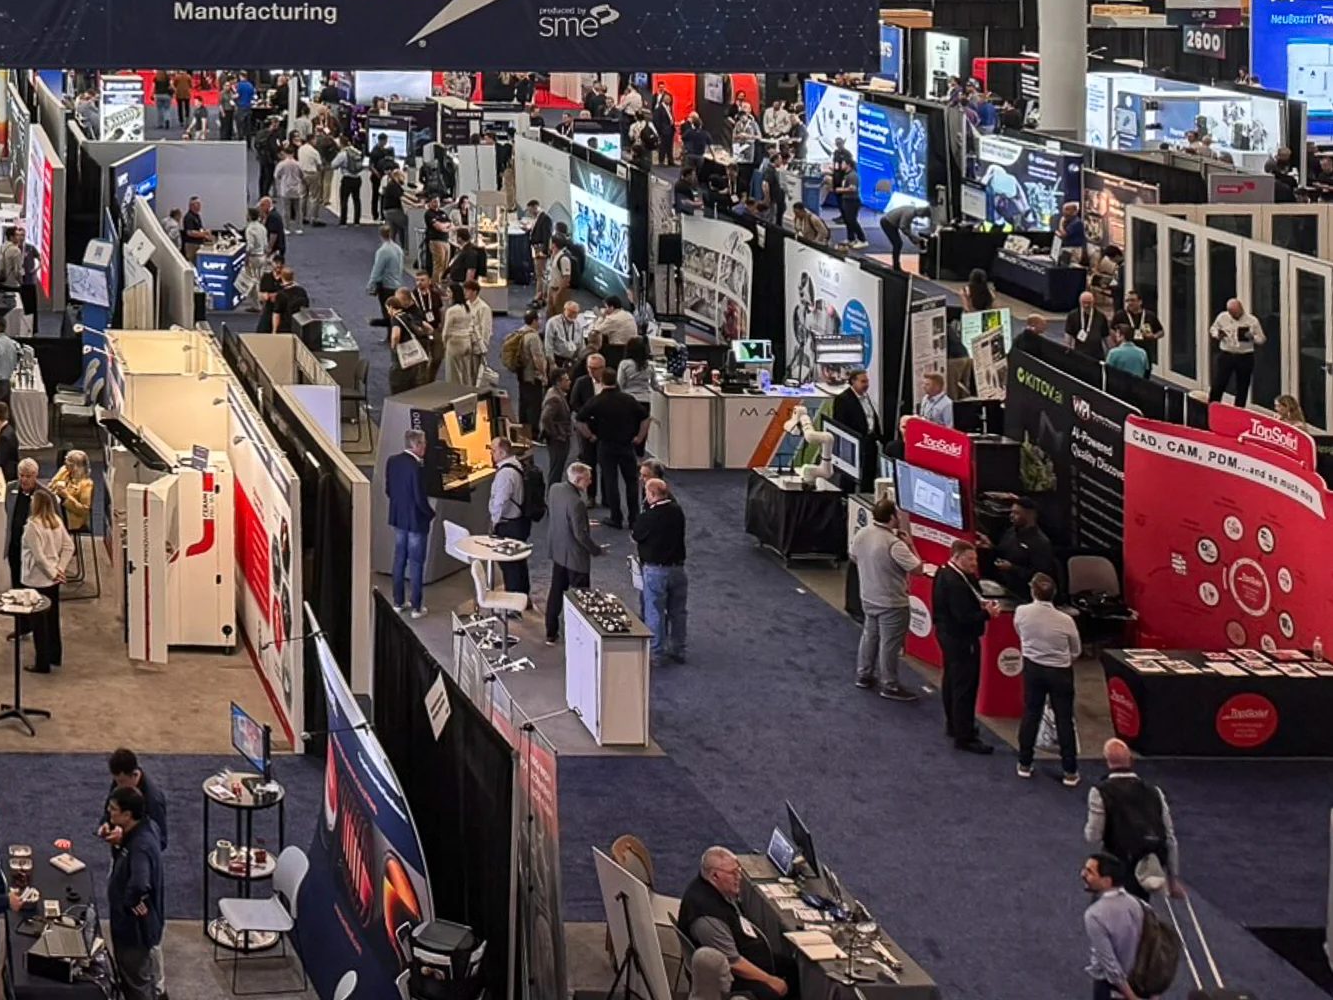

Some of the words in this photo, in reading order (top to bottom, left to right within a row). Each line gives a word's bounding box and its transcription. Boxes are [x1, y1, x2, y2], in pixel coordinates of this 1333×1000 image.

[173, 1, 338, 25] Manufacturing
[539, 6, 575, 15] produced
[577, 6, 587, 16] by
[539, 16, 599, 38] sme
[1186, 31, 1220, 52] 2600
[922, 433, 963, 457] TopSolid
[1250, 418, 1299, 452] TopSolid
[1071, 443, 1096, 468] Quality
[1131, 429, 1162, 450] CAD,
[1166, 440, 1203, 461] CAM,
[1279, 477, 1299, 494] much
